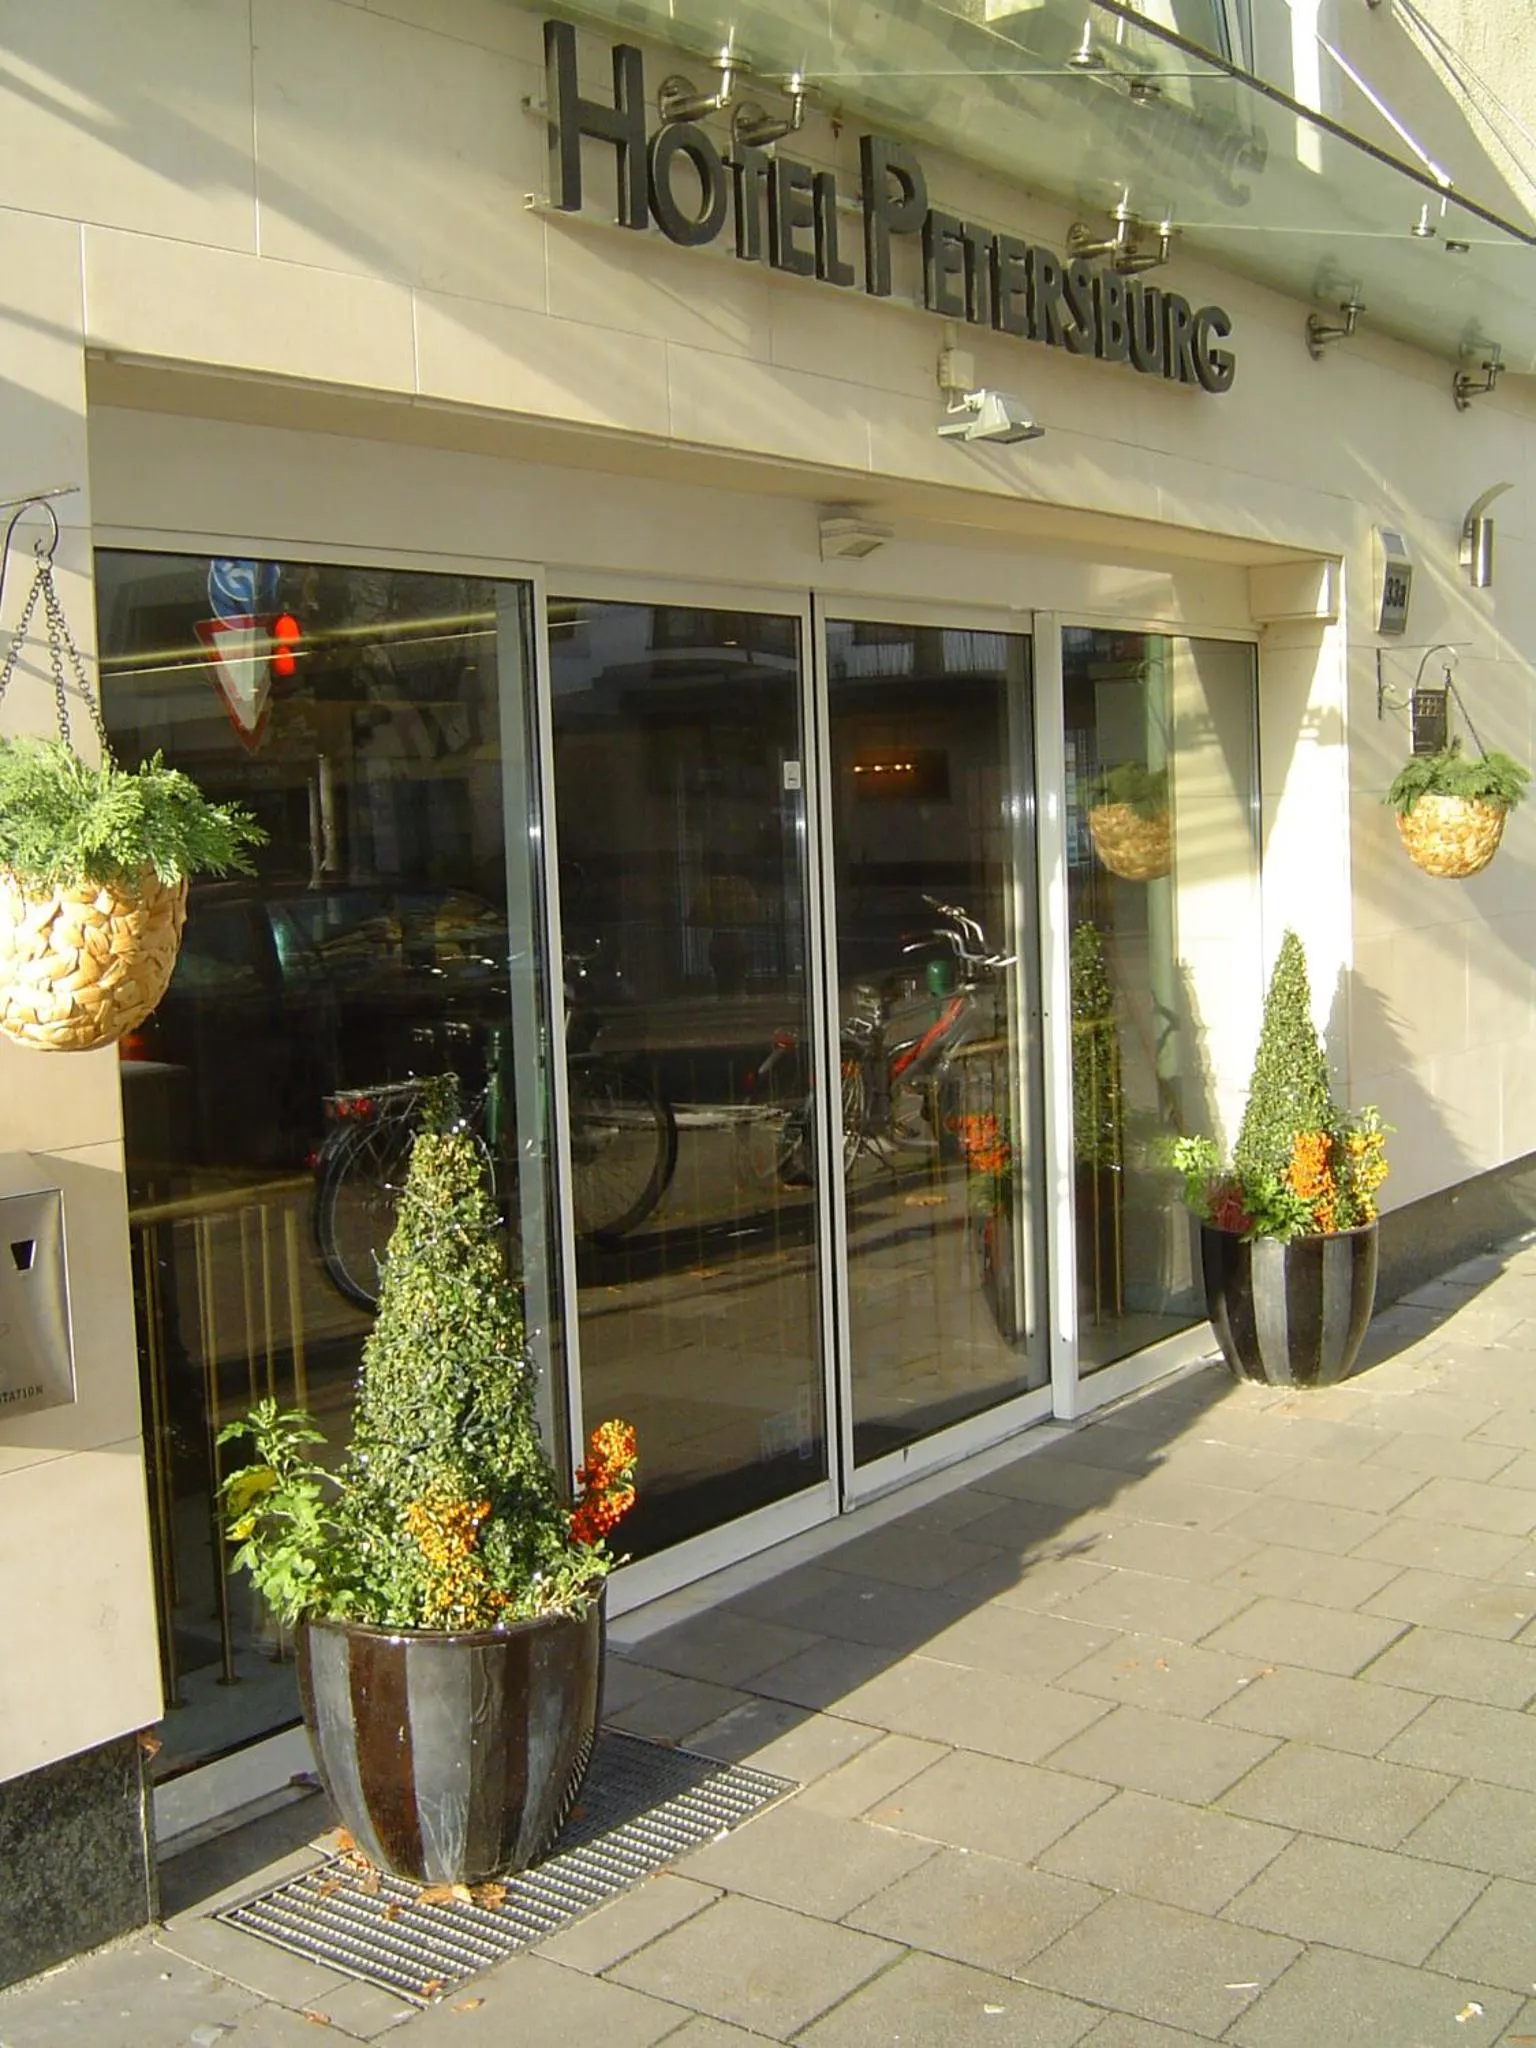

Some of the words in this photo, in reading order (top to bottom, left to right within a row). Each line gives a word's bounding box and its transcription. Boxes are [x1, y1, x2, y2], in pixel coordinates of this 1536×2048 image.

[544, 19, 854, 287] HOTEL
[860, 134, 1236, 394] PETERSBURG
[0, 1384, 43, 1403] TATION
